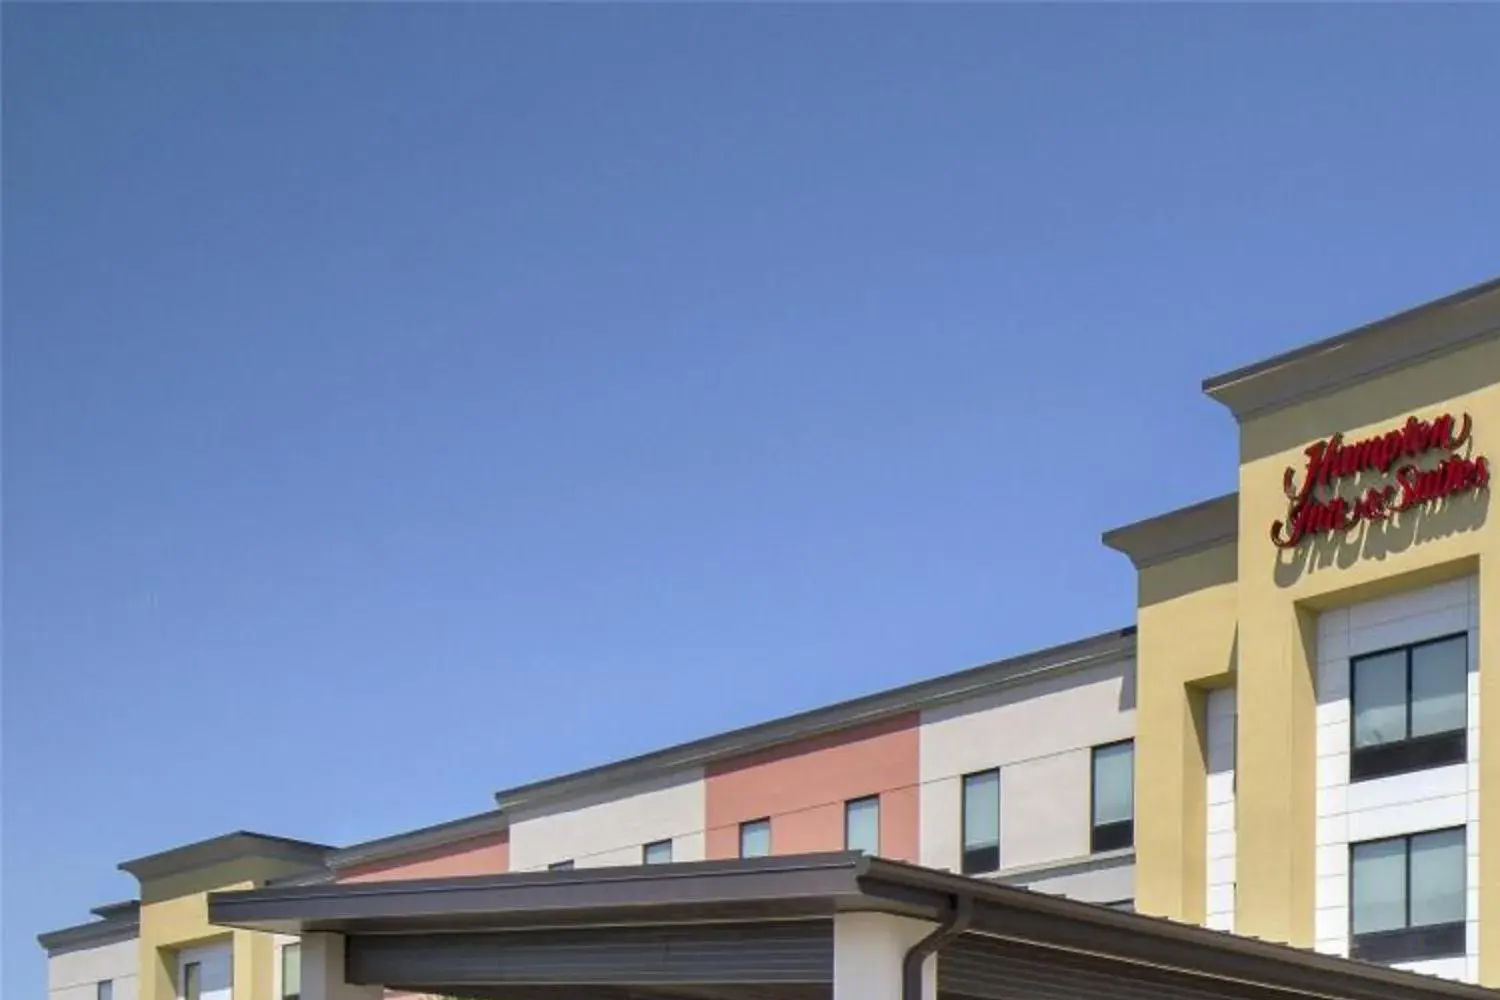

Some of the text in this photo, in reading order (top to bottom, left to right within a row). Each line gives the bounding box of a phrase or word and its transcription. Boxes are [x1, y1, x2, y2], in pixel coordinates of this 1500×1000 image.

[1283, 412, 1472, 500] Hampton
[1271, 497, 1359, 549] Inn
[1391, 455, 1490, 513] Suites
